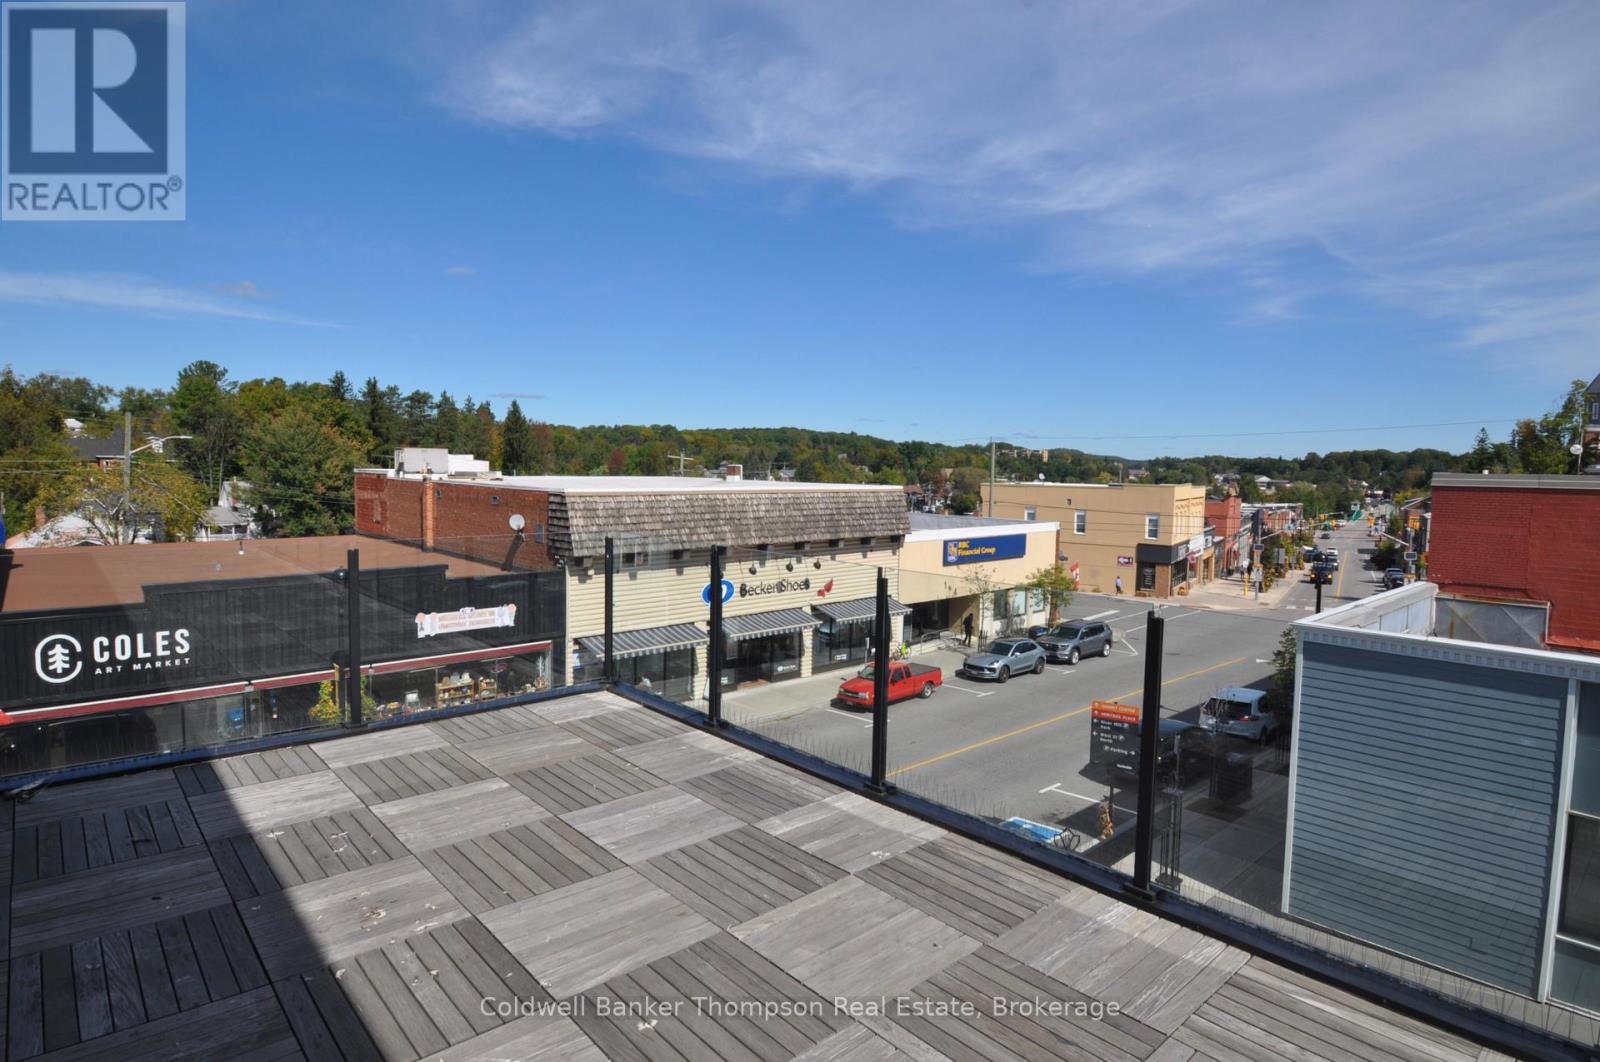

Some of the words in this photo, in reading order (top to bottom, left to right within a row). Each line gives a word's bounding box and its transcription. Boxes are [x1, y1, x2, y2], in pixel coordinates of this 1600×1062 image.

[93, 628, 191, 663] COLES
[94, 665, 123, 675] ART
[132, 657, 191, 671] MARKET
